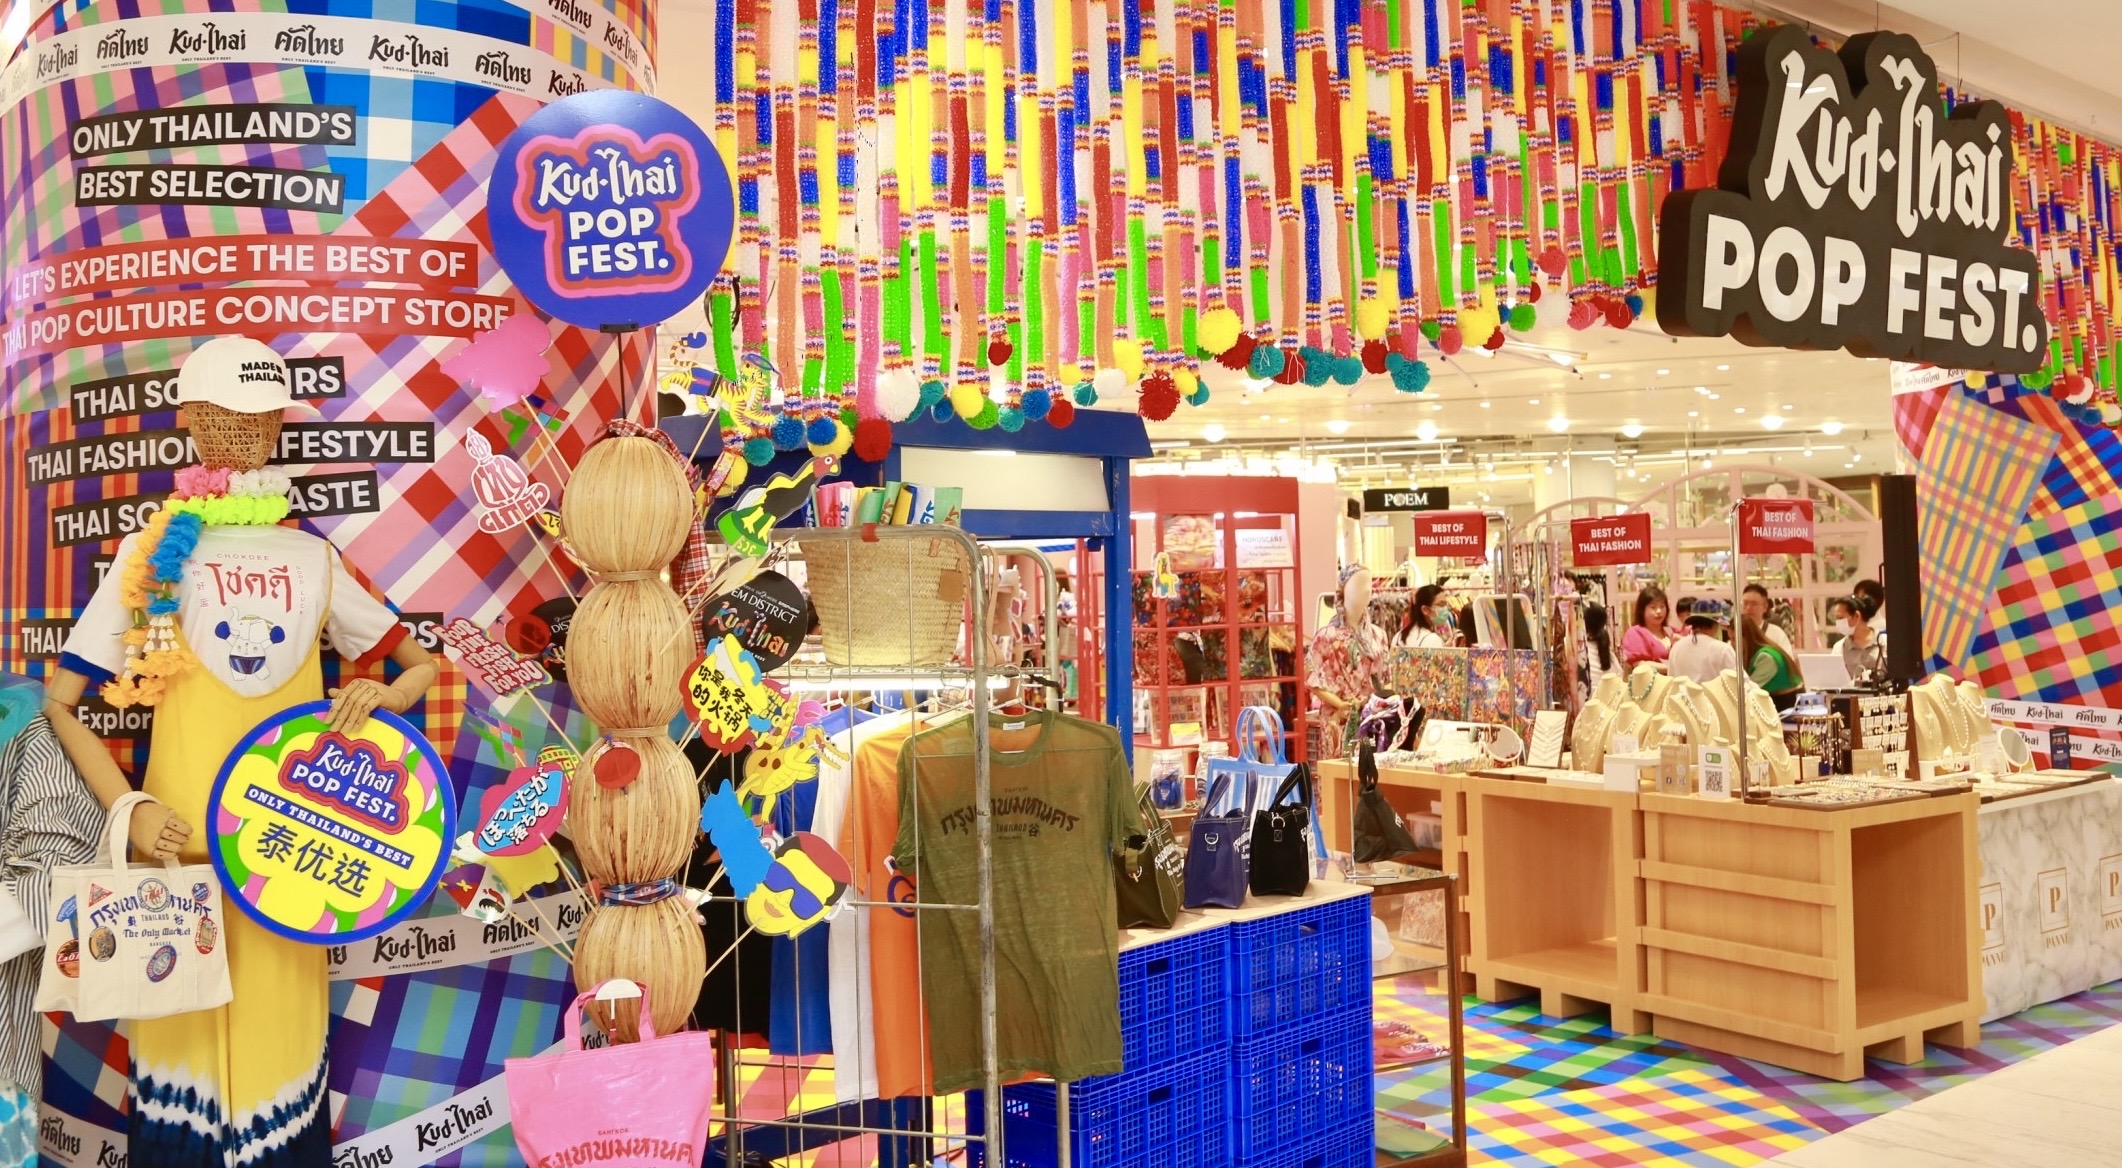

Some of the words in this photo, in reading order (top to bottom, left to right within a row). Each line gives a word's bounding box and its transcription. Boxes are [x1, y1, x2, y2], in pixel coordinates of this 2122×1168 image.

[73, 118, 143, 154] ONLY
[150, 111, 352, 143] THAILAND'S
[79, 171, 143, 199] BEST
[150, 169, 340, 206] SELECTION
[569, 207, 654, 240] POP
[15, 265, 55, 302] LET'S
[61, 245, 237, 289] EXPERIENCE
[247, 244, 315, 272] THE
[326, 245, 410, 274] BEST
[419, 249, 466, 278] OF
[569, 241, 668, 274] FEST.
[1703, 214, 1866, 326] POP
[1887, 247, 2038, 353] FEST.
[2, 324, 27, 357] THAI
[31, 313, 70, 347] POP
[76, 298, 205, 337] CULTURE
[215, 295, 395, 324] CONCEPT
[241, 361, 275, 372] MADE
[74, 383, 136, 419] THAI
[28, 449, 71, 482] THAI
[79, 436, 202, 473] FASHION
[1384, 492, 1429, 507] POEM
[55, 507, 110, 541] THAI
[1432, 524, 1452, 533] BEST
[1452, 523, 1464, 532] OF
[1591, 527, 1613, 539] BEST
[1614, 526, 1626, 538] OF
[1752, 526, 1771, 538] THAI
[1772, 526, 1808, 538] FASHION
[1764, 511, 1785, 523] BEST
[1785, 511, 1796, 522] OF
[1419, 536, 1439, 546] THAI
[1440, 535, 1478, 545] LIFESTYLE
[1578, 541, 1600, 552] THAI
[1601, 540, 1642, 552] FASHION
[204, 563, 292, 614] โชคดี
[748, 594, 797, 624] DISTRICT
[78, 705, 152, 735] Explor
[291, 764, 340, 793] POP
[344, 786, 396, 821] FEST.
[248, 788, 286, 810] ONLY
[289, 804, 373, 849] THAILAND'S
[373, 844, 411, 866] BEST
[257, 822, 372, 898] 泰优选
[2049, 886, 2061, 913] P
[2109, 871, 2119, 897] P
[1984, 903, 1996, 931] P
[123, 928, 139, 938] The
[141, 929, 160, 939] Only
